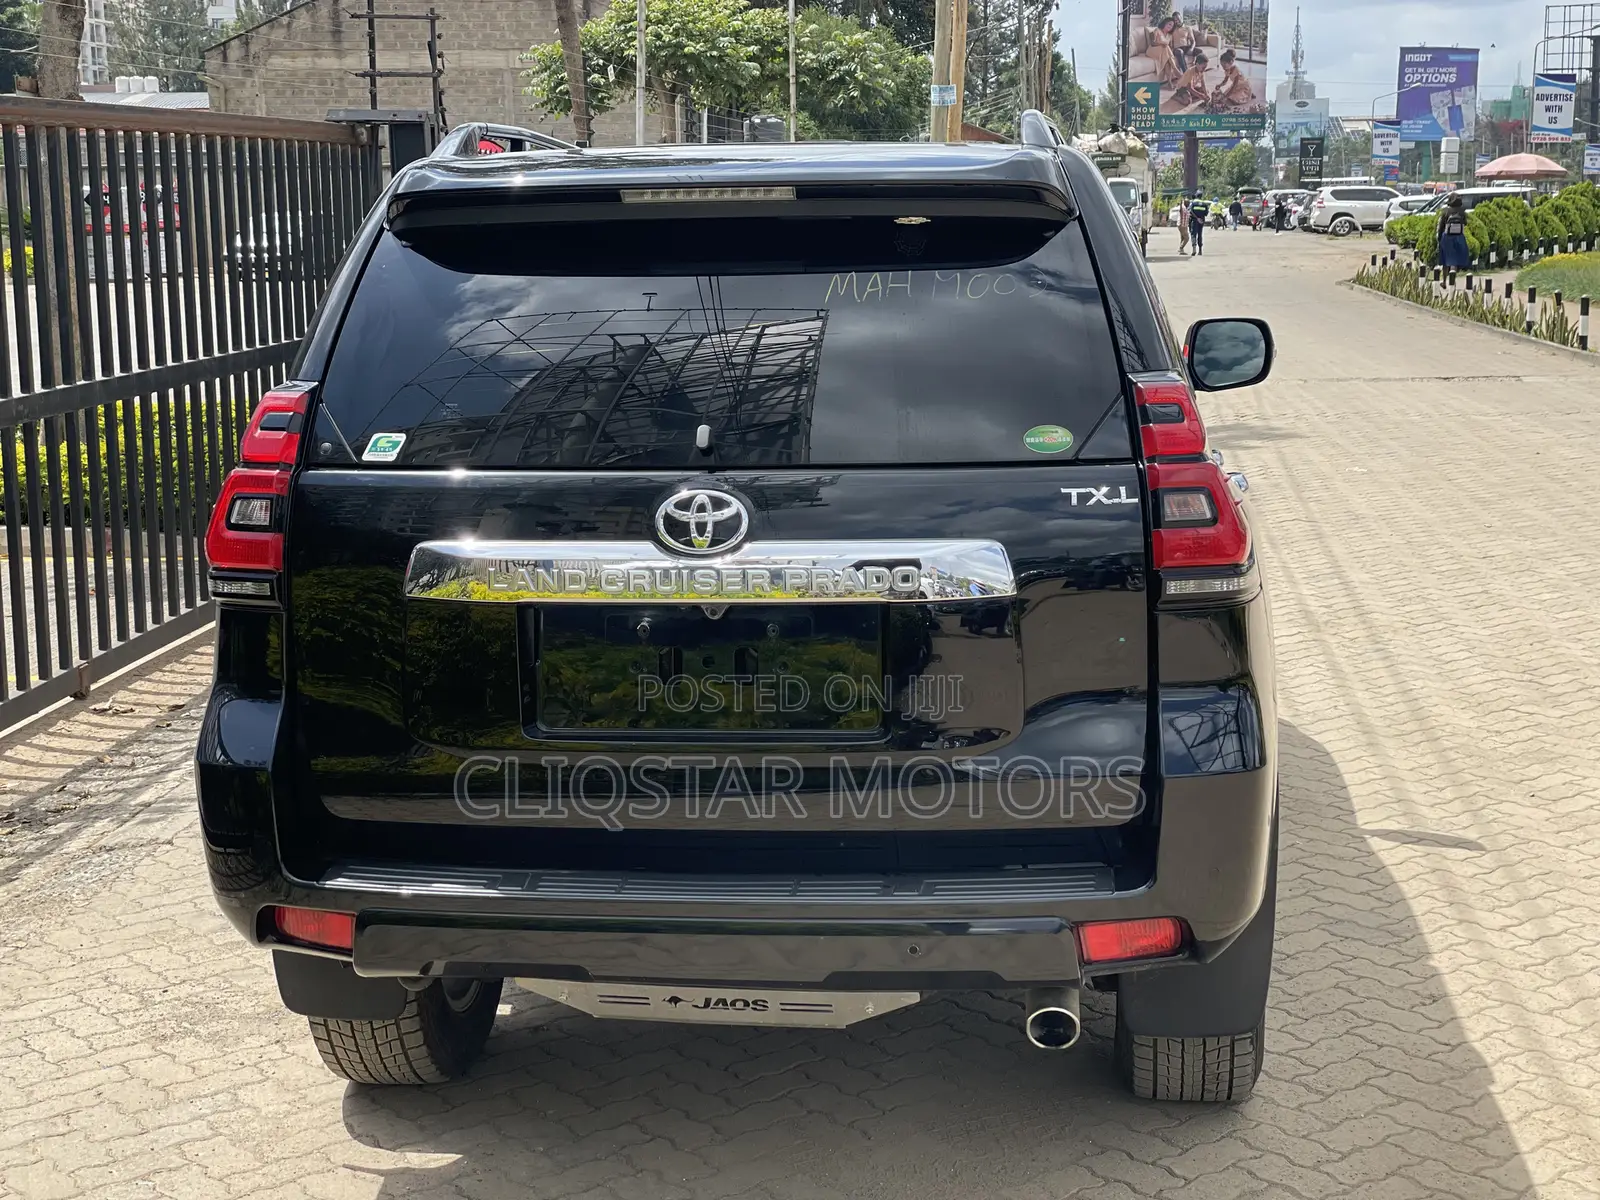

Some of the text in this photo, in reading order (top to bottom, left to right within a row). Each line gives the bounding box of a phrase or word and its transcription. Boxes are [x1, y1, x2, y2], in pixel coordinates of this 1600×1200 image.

[1404, 73, 1457, 83] OPTIONS
[1535, 93, 1573, 102] ADVERTISE
[1544, 105, 1563, 113] WITH
[1548, 116, 1558, 124] US
[825, 270, 912, 303] MAH
[488, 566, 921, 594] LAND CRUISER PRADO
[692, 997, 769, 1012] JAOS
